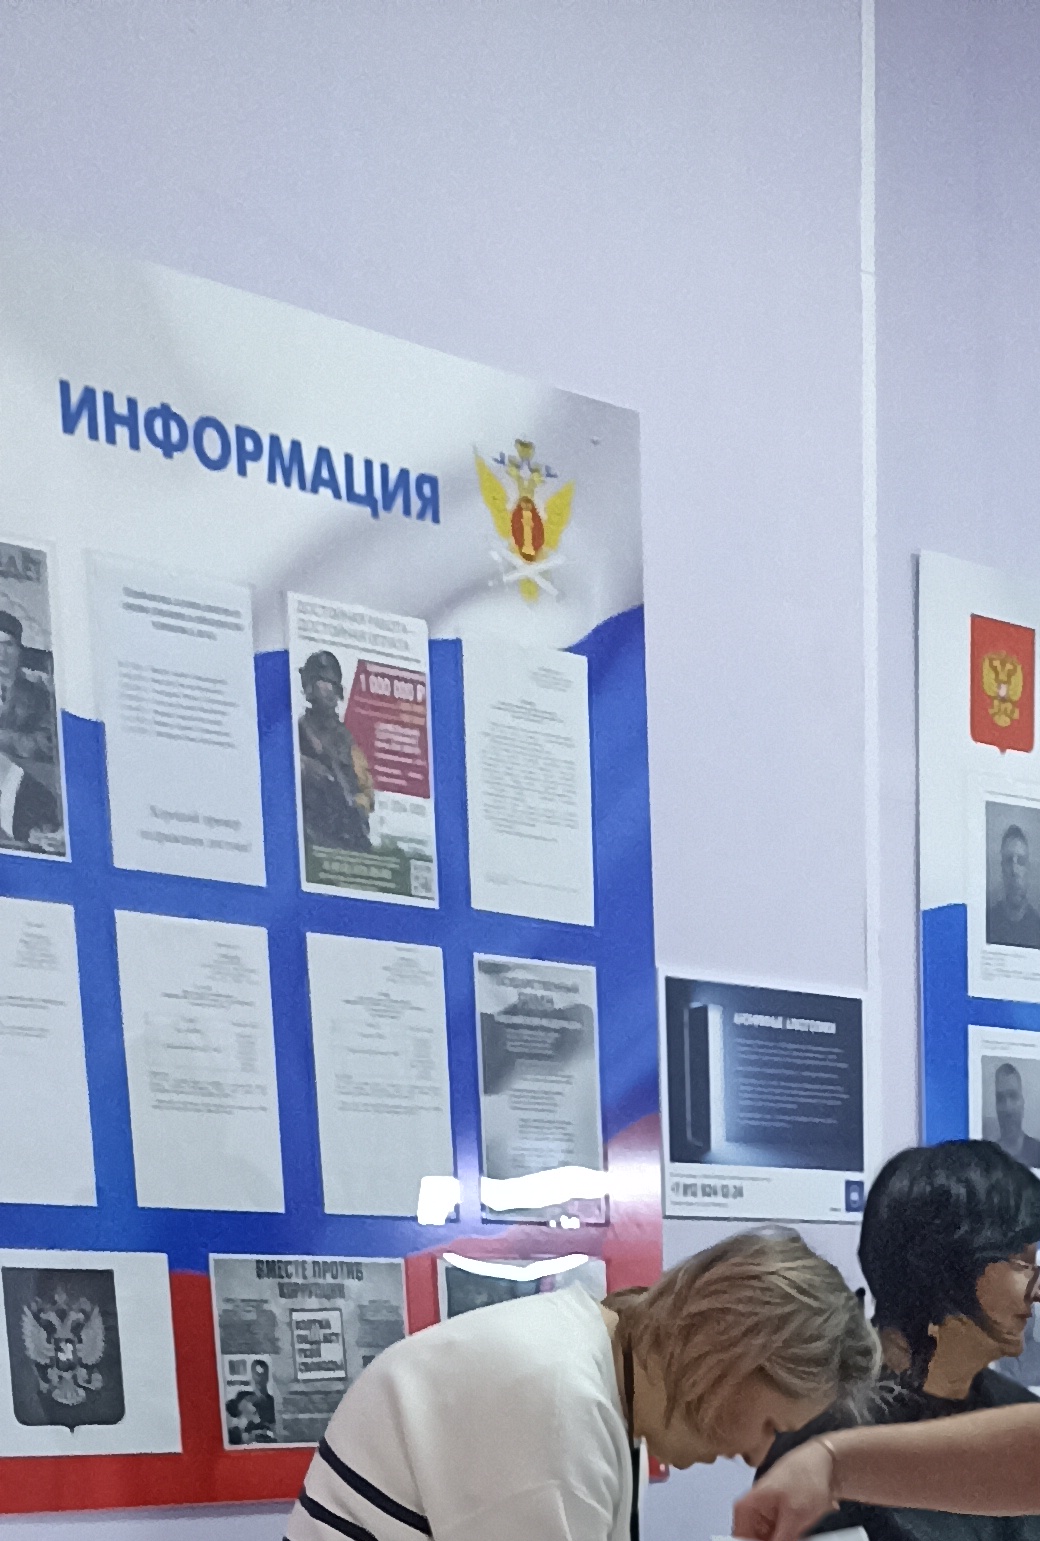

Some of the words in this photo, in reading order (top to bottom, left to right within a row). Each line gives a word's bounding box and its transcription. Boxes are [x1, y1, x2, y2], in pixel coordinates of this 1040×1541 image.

[58, 378, 441, 524] ИНФОРМАЦИЯ
[255, 1259, 308, 1281] ВМЕСТЕ
[311, 1260, 364, 1282] ПРОТИВ
